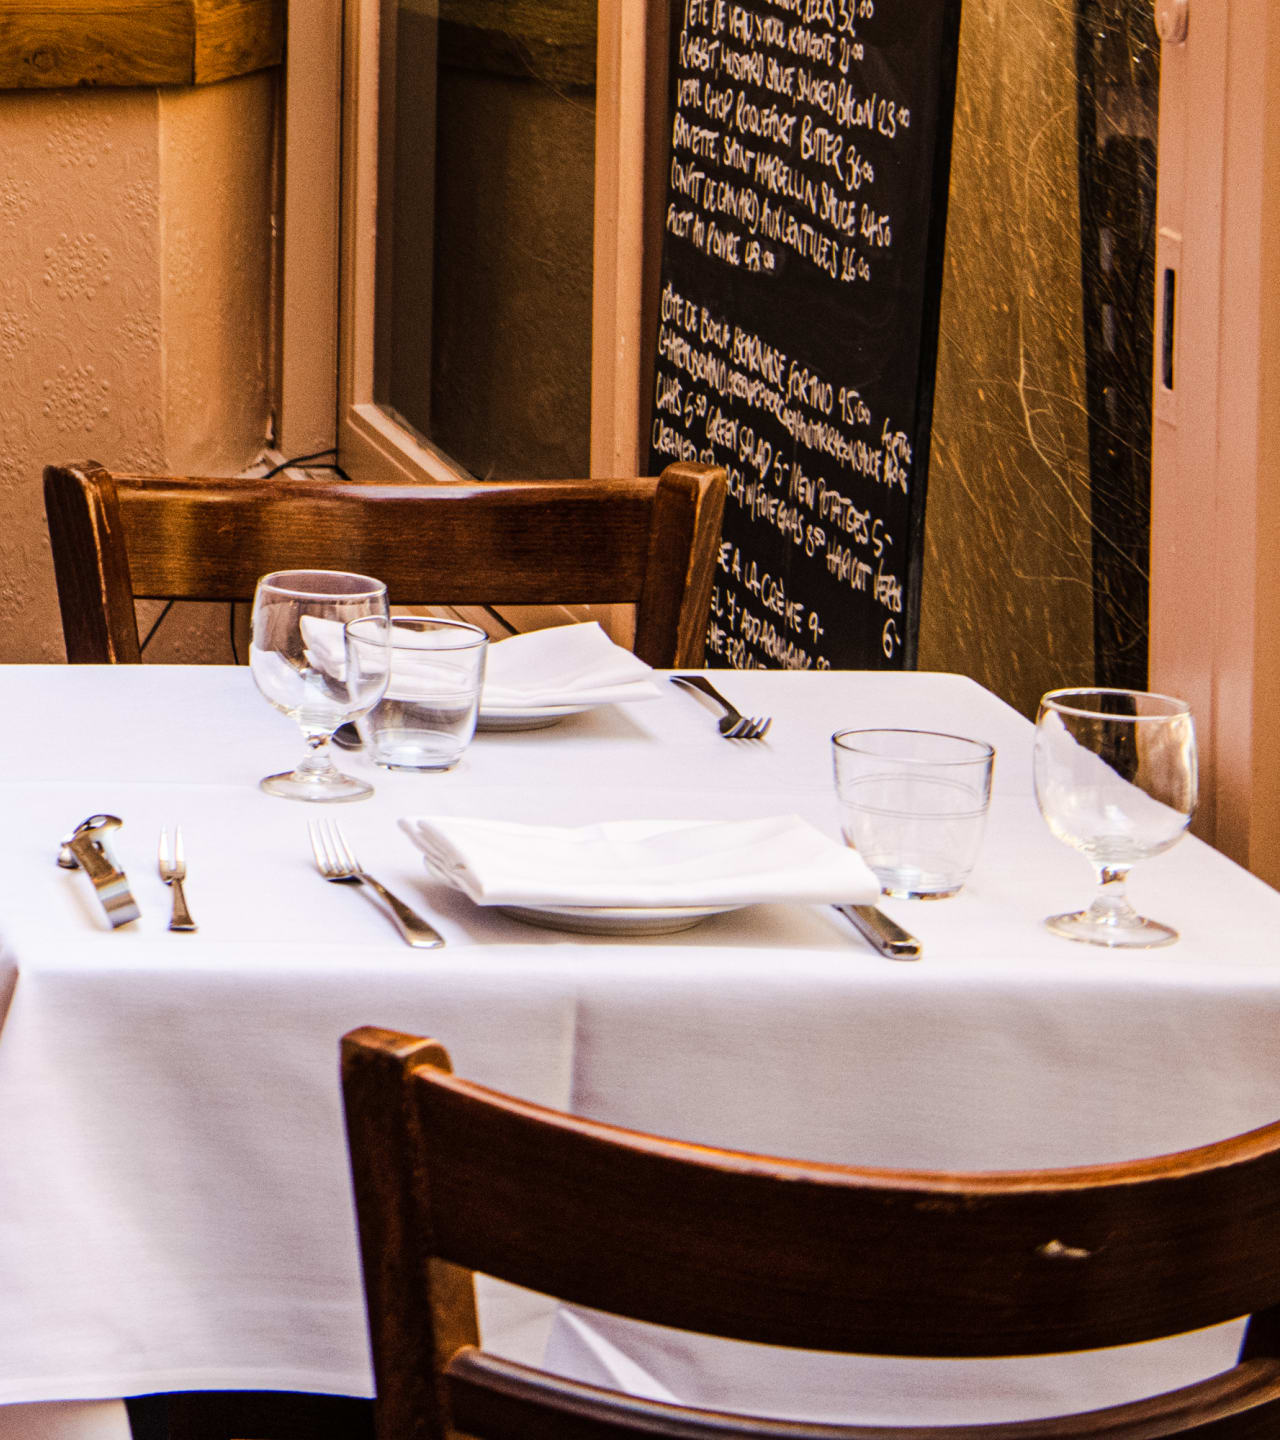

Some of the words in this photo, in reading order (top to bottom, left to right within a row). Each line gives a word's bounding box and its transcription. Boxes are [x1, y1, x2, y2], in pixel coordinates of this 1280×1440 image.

[703, 177, 718, 212] DE
[684, 300, 698, 333] DE
[743, 561, 761, 597] LA
